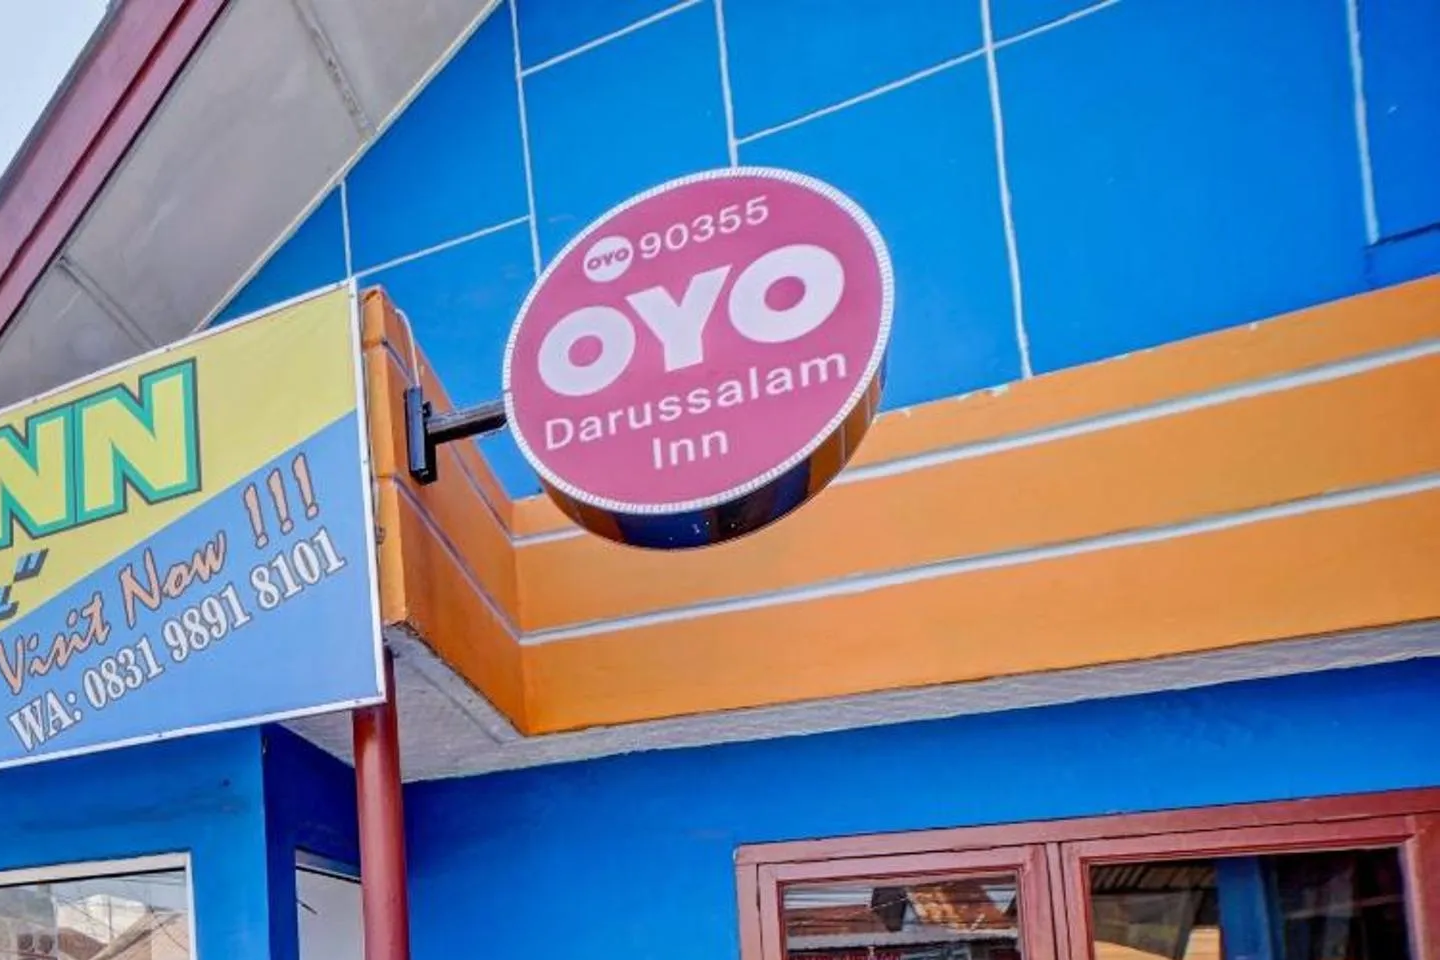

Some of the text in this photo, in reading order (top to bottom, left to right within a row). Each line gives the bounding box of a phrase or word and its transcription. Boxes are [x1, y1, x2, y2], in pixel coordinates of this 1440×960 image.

[587, 195, 770, 270] OYO 90355
[537, 243, 846, 397] OYO
[544, 352, 848, 451] Darussalam
[651, 430, 730, 470] Inn
[119, 532, 228, 629] Now
[7, 526, 347, 753] WA: 0831 9891 8101
